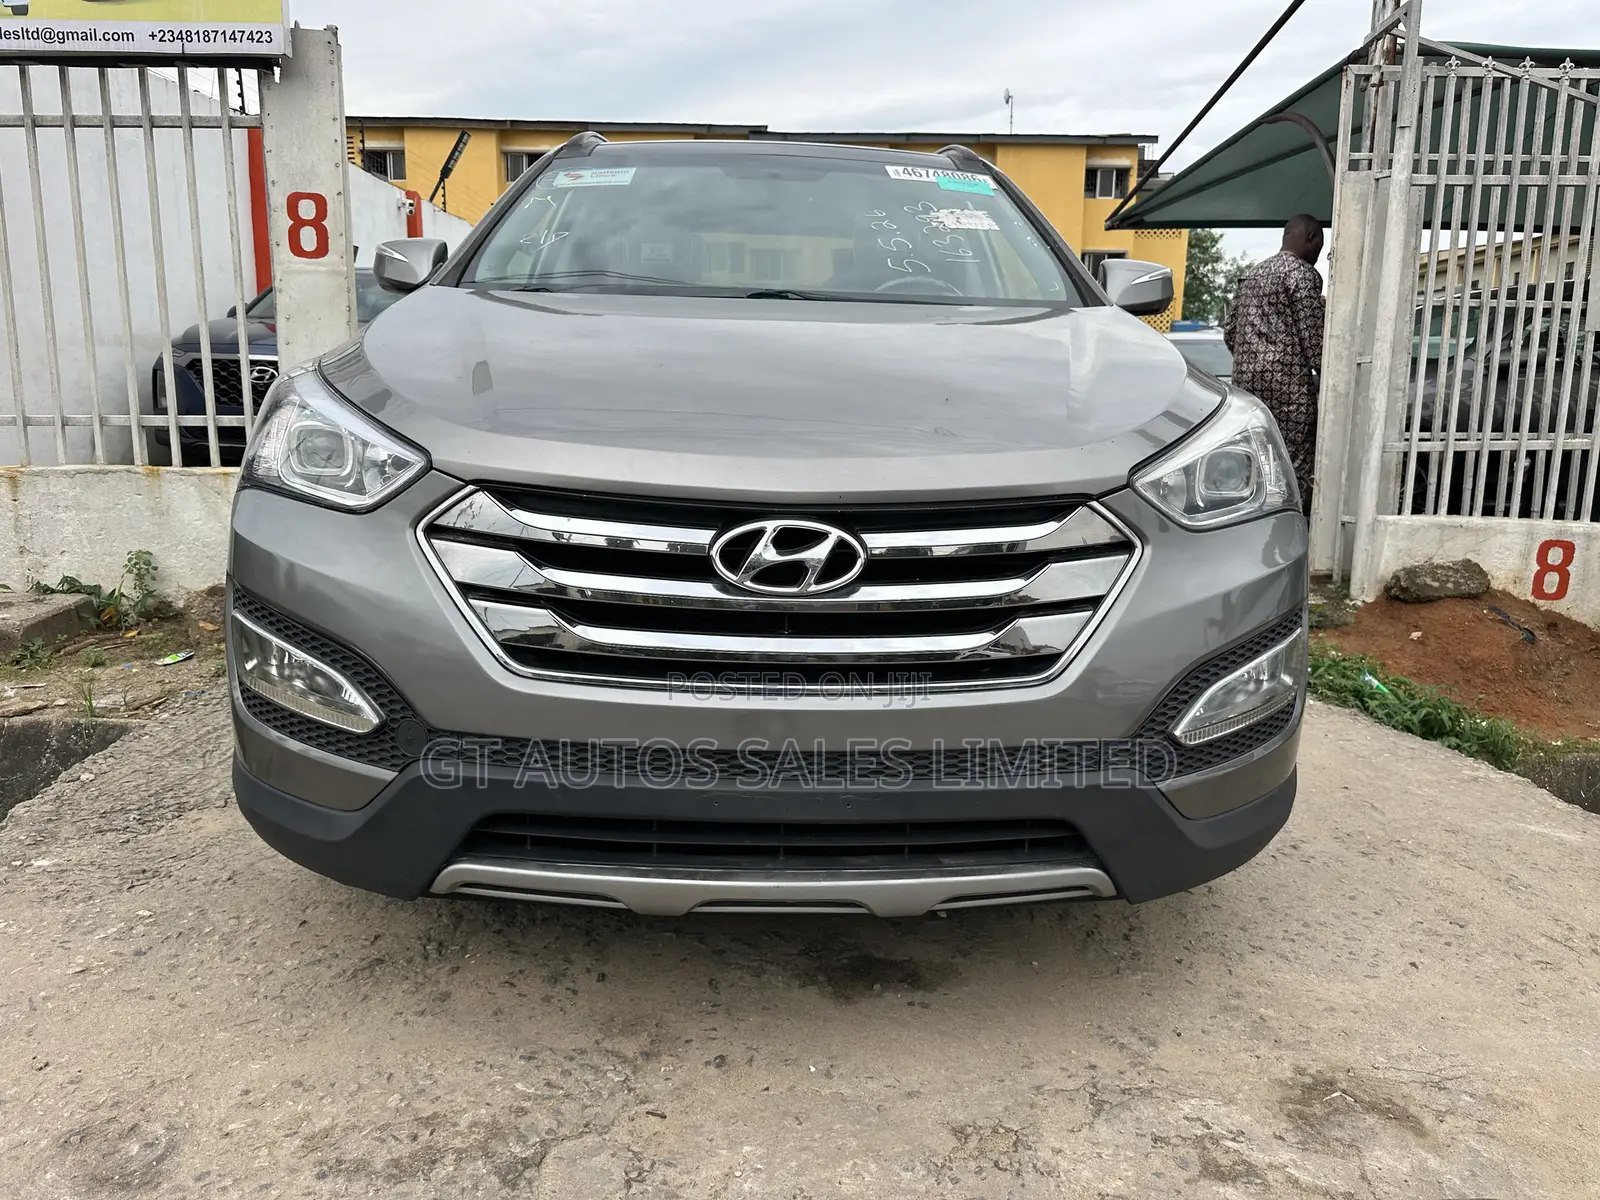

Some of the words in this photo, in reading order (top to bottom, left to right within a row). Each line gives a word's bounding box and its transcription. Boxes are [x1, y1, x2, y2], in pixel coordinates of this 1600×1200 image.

[148, 29, 273, 43] +2348187147423
[286, 191, 329, 259] 8
[1531, 539, 1575, 600] 8
